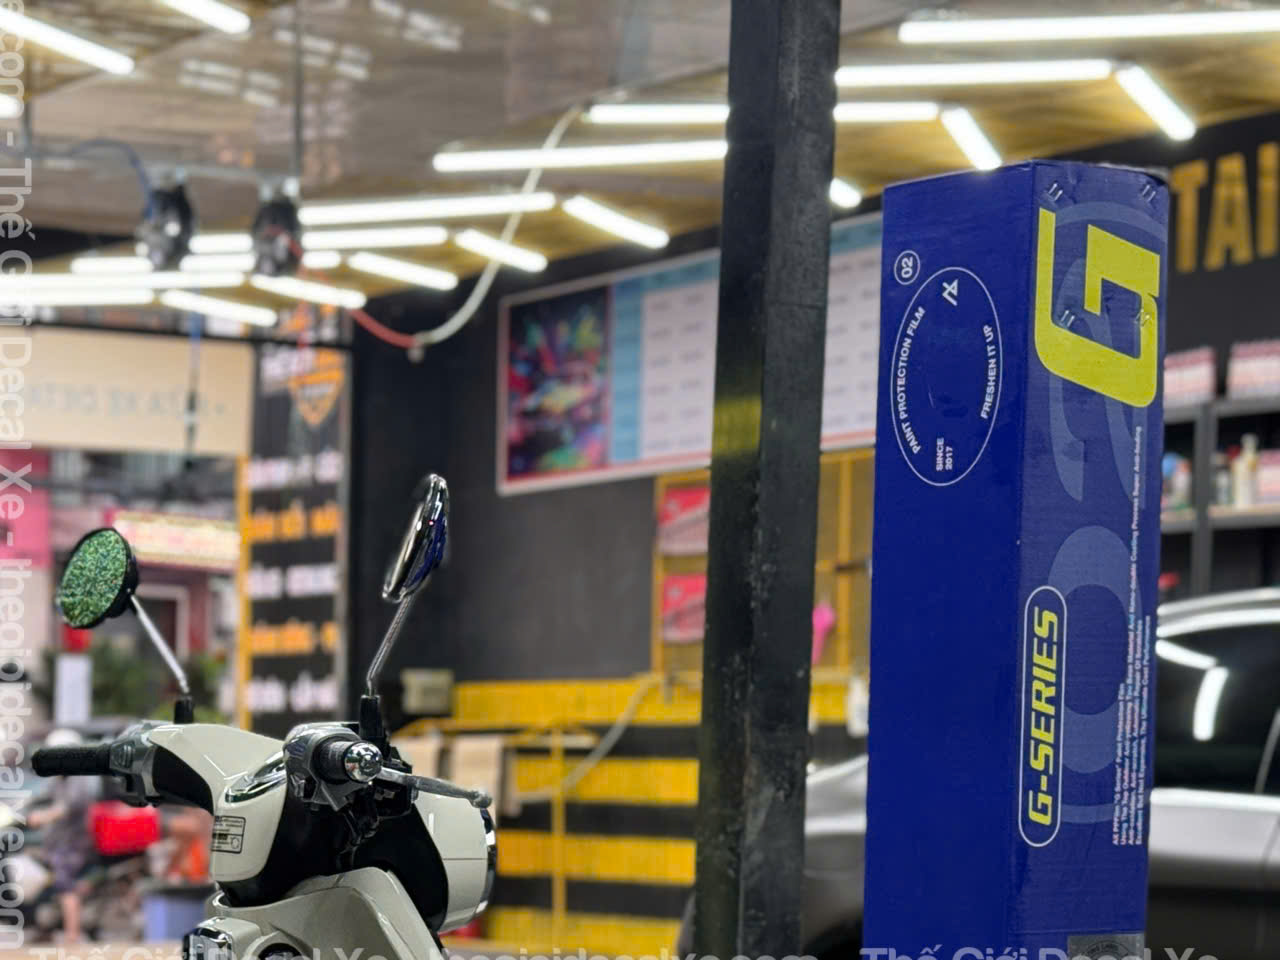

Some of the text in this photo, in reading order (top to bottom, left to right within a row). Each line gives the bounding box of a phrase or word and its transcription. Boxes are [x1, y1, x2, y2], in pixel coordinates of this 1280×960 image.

[901, 256, 914, 279] 02
[896, 306, 926, 454] PAINT PROTECTION FILM
[980, 324, 998, 419] FRESHEN IT UP
[935, 437, 945, 471] SINCE
[945, 446, 953, 470] 2017
[1028, 606, 1058, 826] G-SERIES
